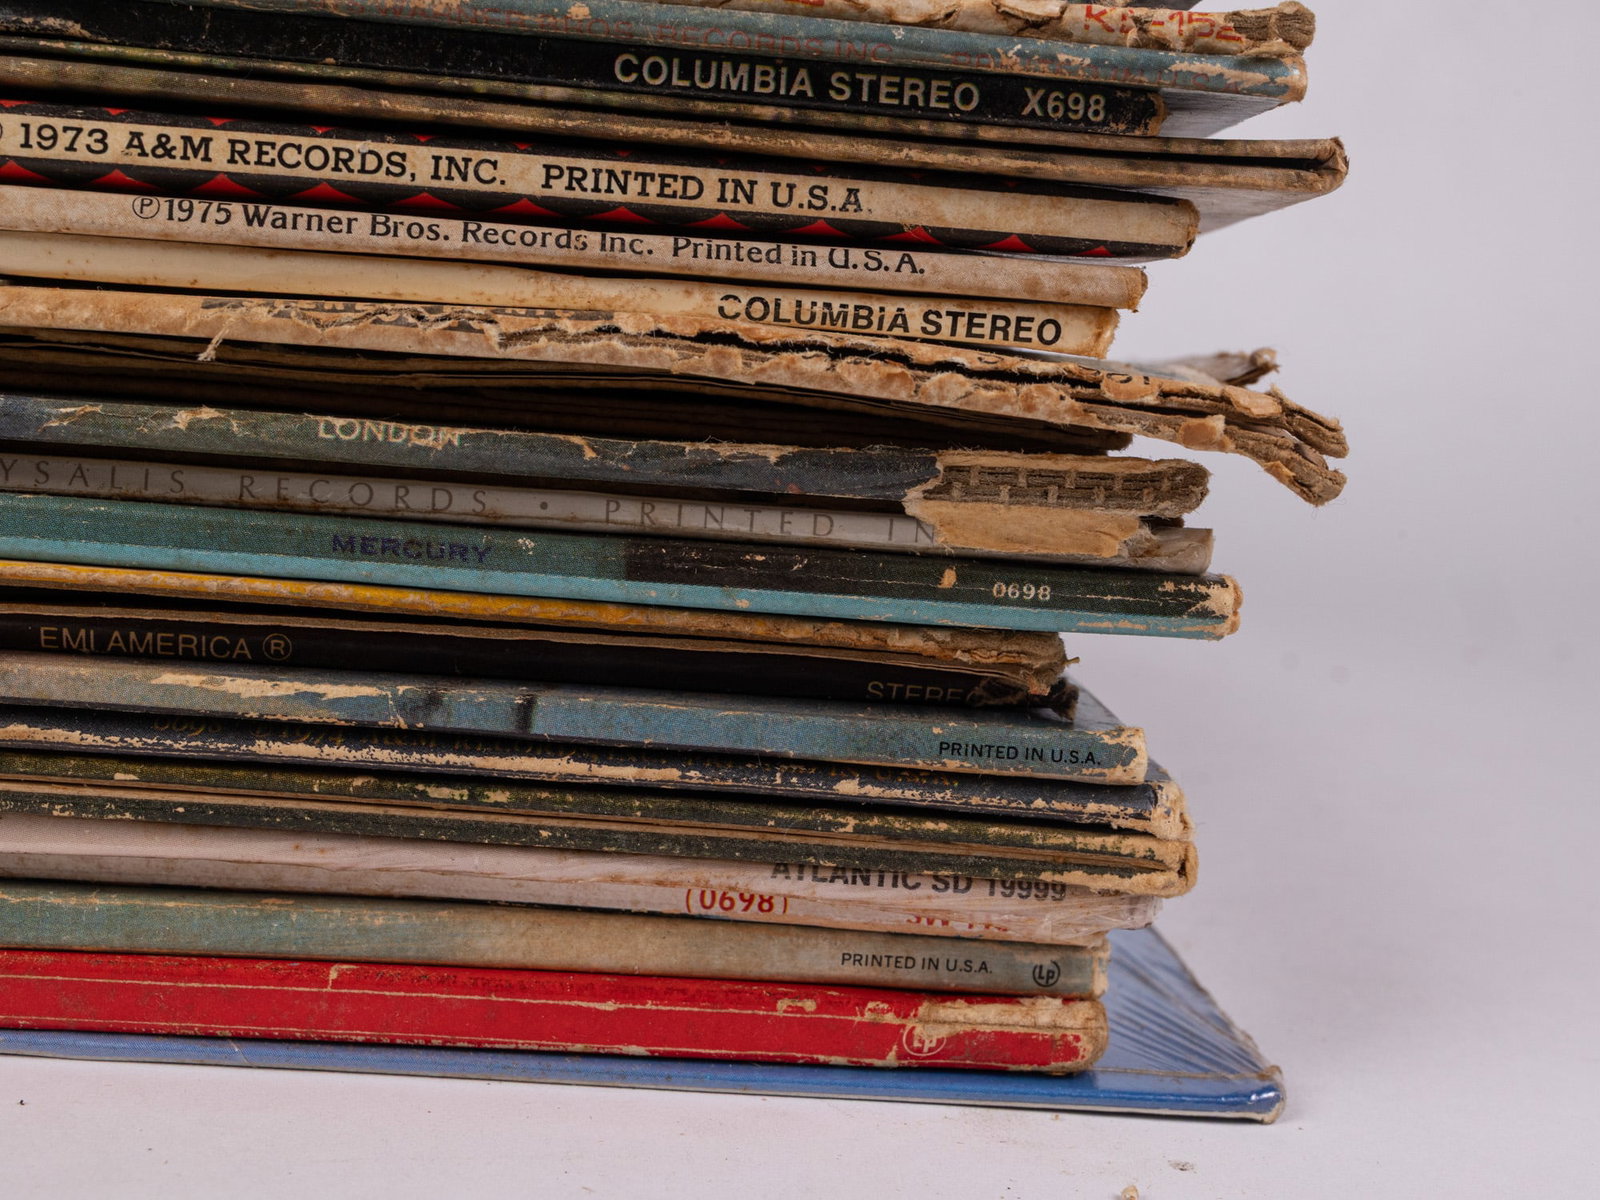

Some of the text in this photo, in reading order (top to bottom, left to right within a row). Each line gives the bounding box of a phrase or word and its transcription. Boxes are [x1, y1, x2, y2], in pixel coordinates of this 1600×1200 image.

[614, 53, 1107, 122] COLUMBIA STEREO X698
[19, 122, 109, 155] 1973
[125, 131, 214, 163] A&M
[226, 139, 417, 183] RECORDS,
[430, 155, 507, 187] INC.
[540, 163, 705, 202] PRINTED
[717, 177, 759, 205] IN
[241, 204, 358, 236] Warner
[369, 214, 450, 243] Bros.
[461, 221, 589, 252] Records
[600, 232, 654, 257] Inc.
[671, 236, 783, 264] Printed
[791, 244, 817, 267] in
[827, 247, 926, 275] U.S.A.
[717, 293, 1063, 347] COLUMBIA STEREO
[318, 417, 461, 448] LONDON
[239, 474, 488, 515] RECORDS
[604, 499, 835, 537] PRINTED
[887, 513, 936, 544] IN
[331, 533, 494, 565] MERCURY
[992, 581, 1052, 602] 0698
[39, 626, 96, 652] EMI
[107, 629, 253, 660] AMERICA
[938, 740, 1102, 767] PRINTED IN U.S.A.
[770, 861, 923, 891] ATLANTIC
[931, 873, 973, 895] SD
[840, 952, 994, 975] PRINTED IN U.S.A.
